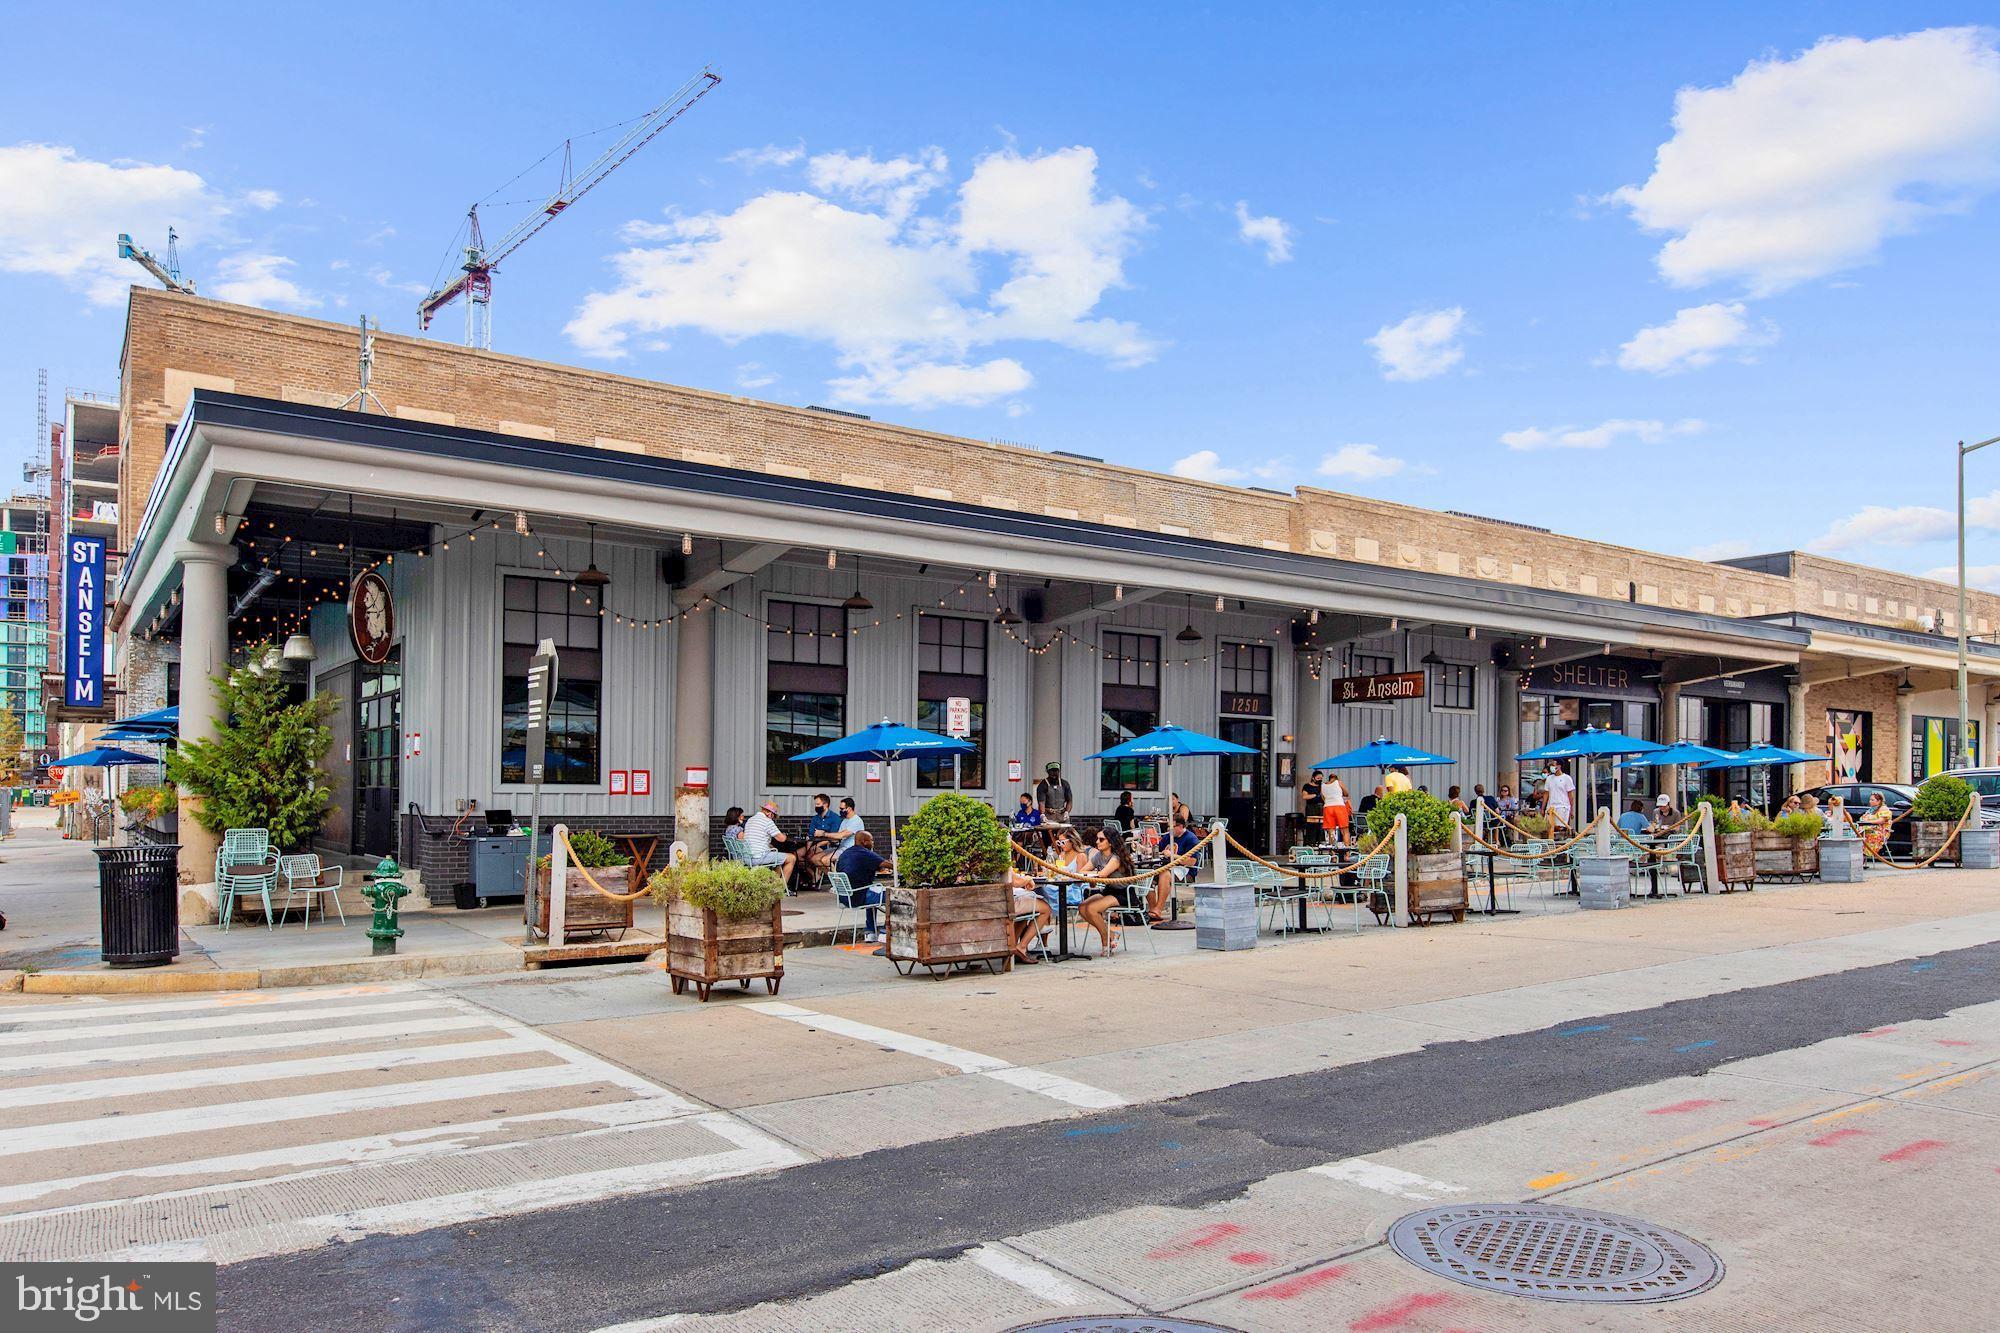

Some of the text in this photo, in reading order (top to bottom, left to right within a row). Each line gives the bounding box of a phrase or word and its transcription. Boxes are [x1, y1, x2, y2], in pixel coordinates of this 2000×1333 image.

[73, 541, 100, 564] ST
[75, 566, 94, 702] ANSELM
[1552, 663, 1628, 689] SHELTER
[1342, 677, 1414, 699] St. Anselm
[1231, 698, 1258, 712] 1250
